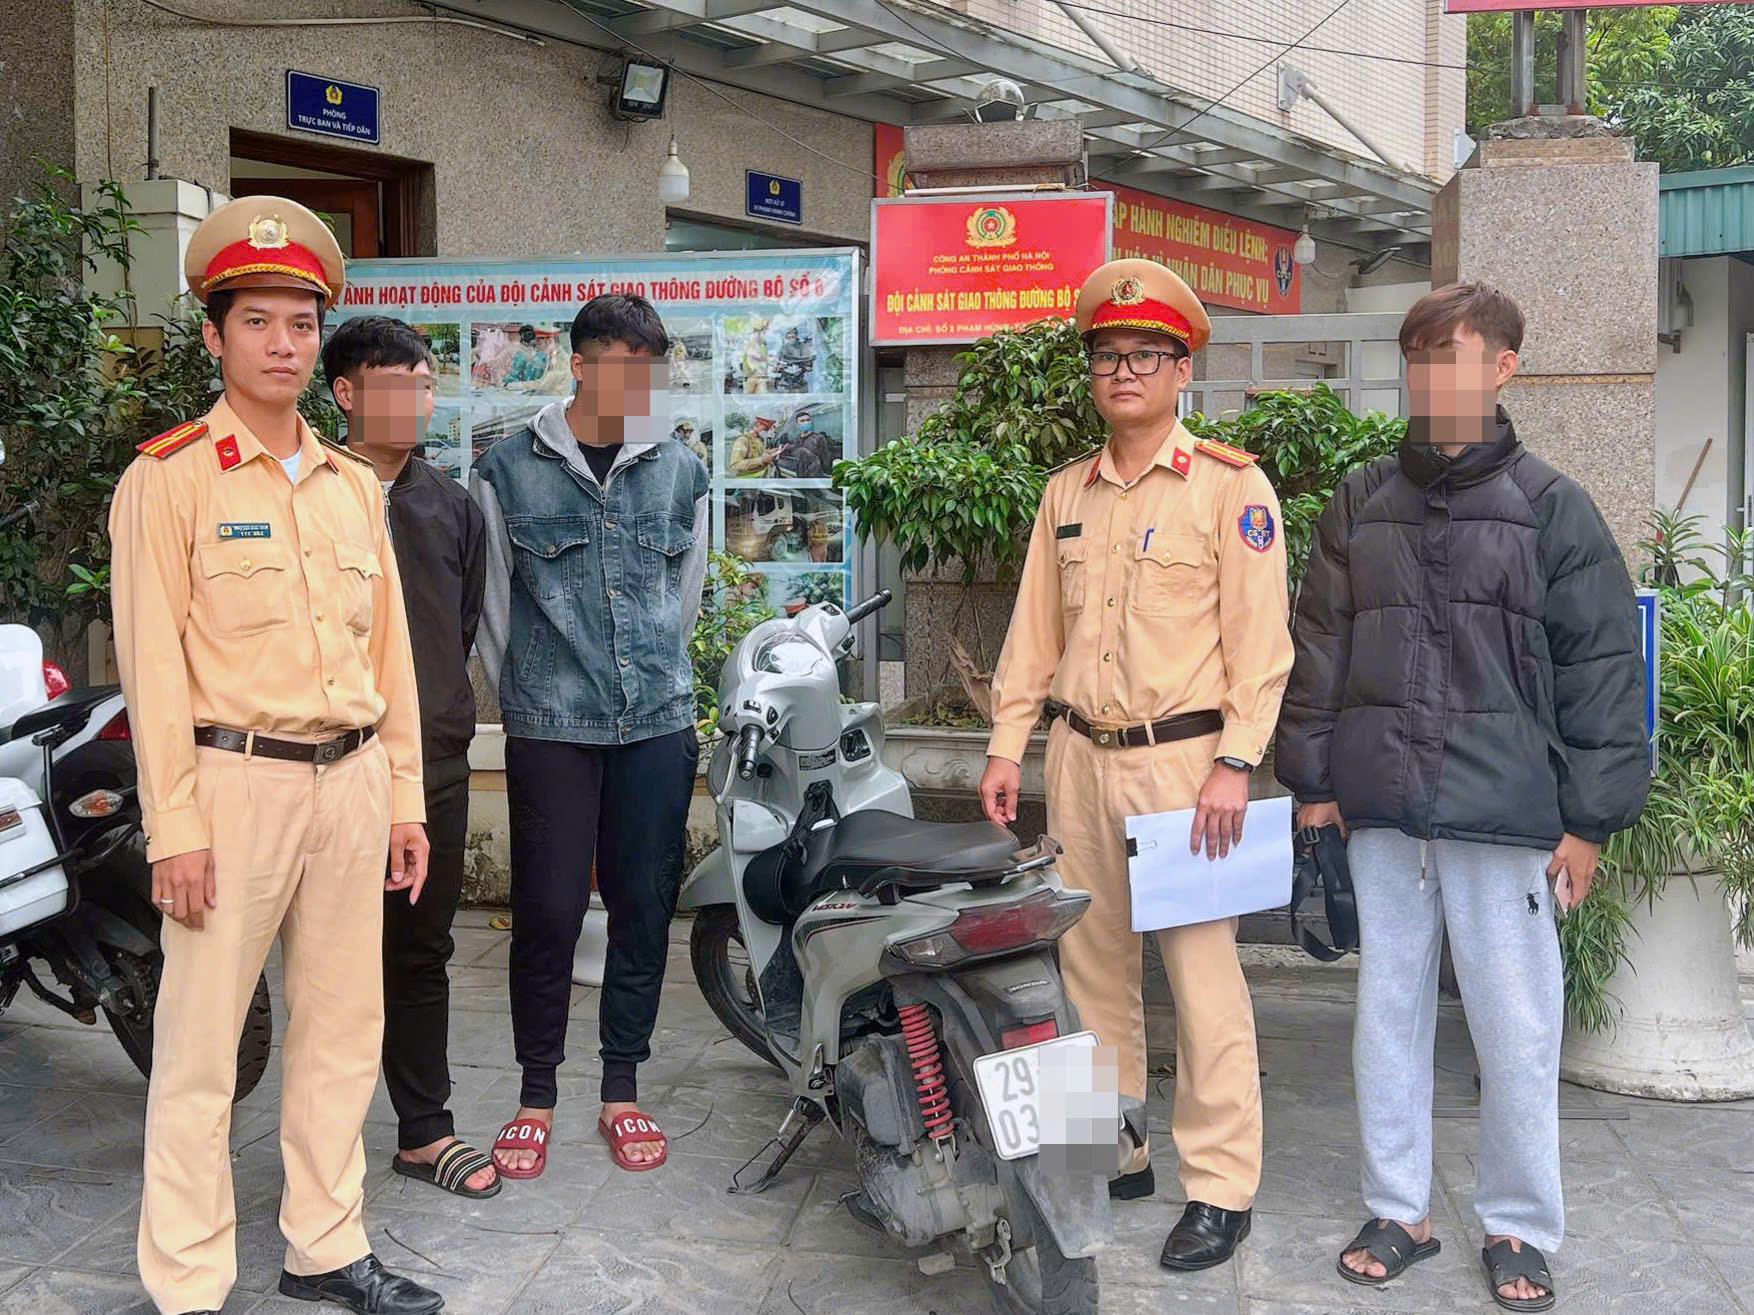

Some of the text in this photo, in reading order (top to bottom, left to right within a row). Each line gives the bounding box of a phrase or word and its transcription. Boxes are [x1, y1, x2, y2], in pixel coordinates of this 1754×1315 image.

[298, 114, 316, 125] TRỰC
[317, 119, 331, 128] BAN
[323, 108, 346, 119] PHÒNG
[1130, 200, 1163, 238] HÀNH
[1166, 214, 1210, 249] NGHIÊM
[1213, 217, 1237, 255] ĐIỀU
[933, 254, 957, 263] CÔNG
[973, 252, 1000, 261] THÀNH
[1002, 250, 1020, 260] PHỐ
[1021, 251, 1033, 260] HÀ
[1035, 250, 1050, 261] NỘI
[929, 262, 1054, 274] PHÒNG CẢNH SÁT GIAO THÔNG
[378, 284, 416, 309] HOẠT
[420, 281, 461, 308] ĐỘNG
[466, 278, 496, 304] CỦA
[501, 280, 526, 307] ĐỘI
[530, 277, 572, 302] CẢNH
[576, 278, 606, 302] SÁT
[610, 281, 645, 295] GIAO
[650, 277, 700, 300] THÔNG
[705, 275, 758, 300] ĐƯỜNG
[789, 271, 810, 298] SỐ
[1201, 261, 1224, 295] DÂN
[1226, 270, 1254, 304] PHỤC
[1256, 277, 1270, 309] VỤ
[887, 290, 904, 316] ĐỘI
[906, 287, 934, 312] CẢNH
[936, 288, 956, 311] SÁT
[958, 291, 981, 311] GIAO
[984, 287, 1017, 310] THÔNG
[1019, 284, 1055, 309] ĐƯỜNG
[1057, 284, 1072, 312] BỘ
[497, 1124, 545, 1145] ICON
[615, 1118, 661, 1137] ICON
